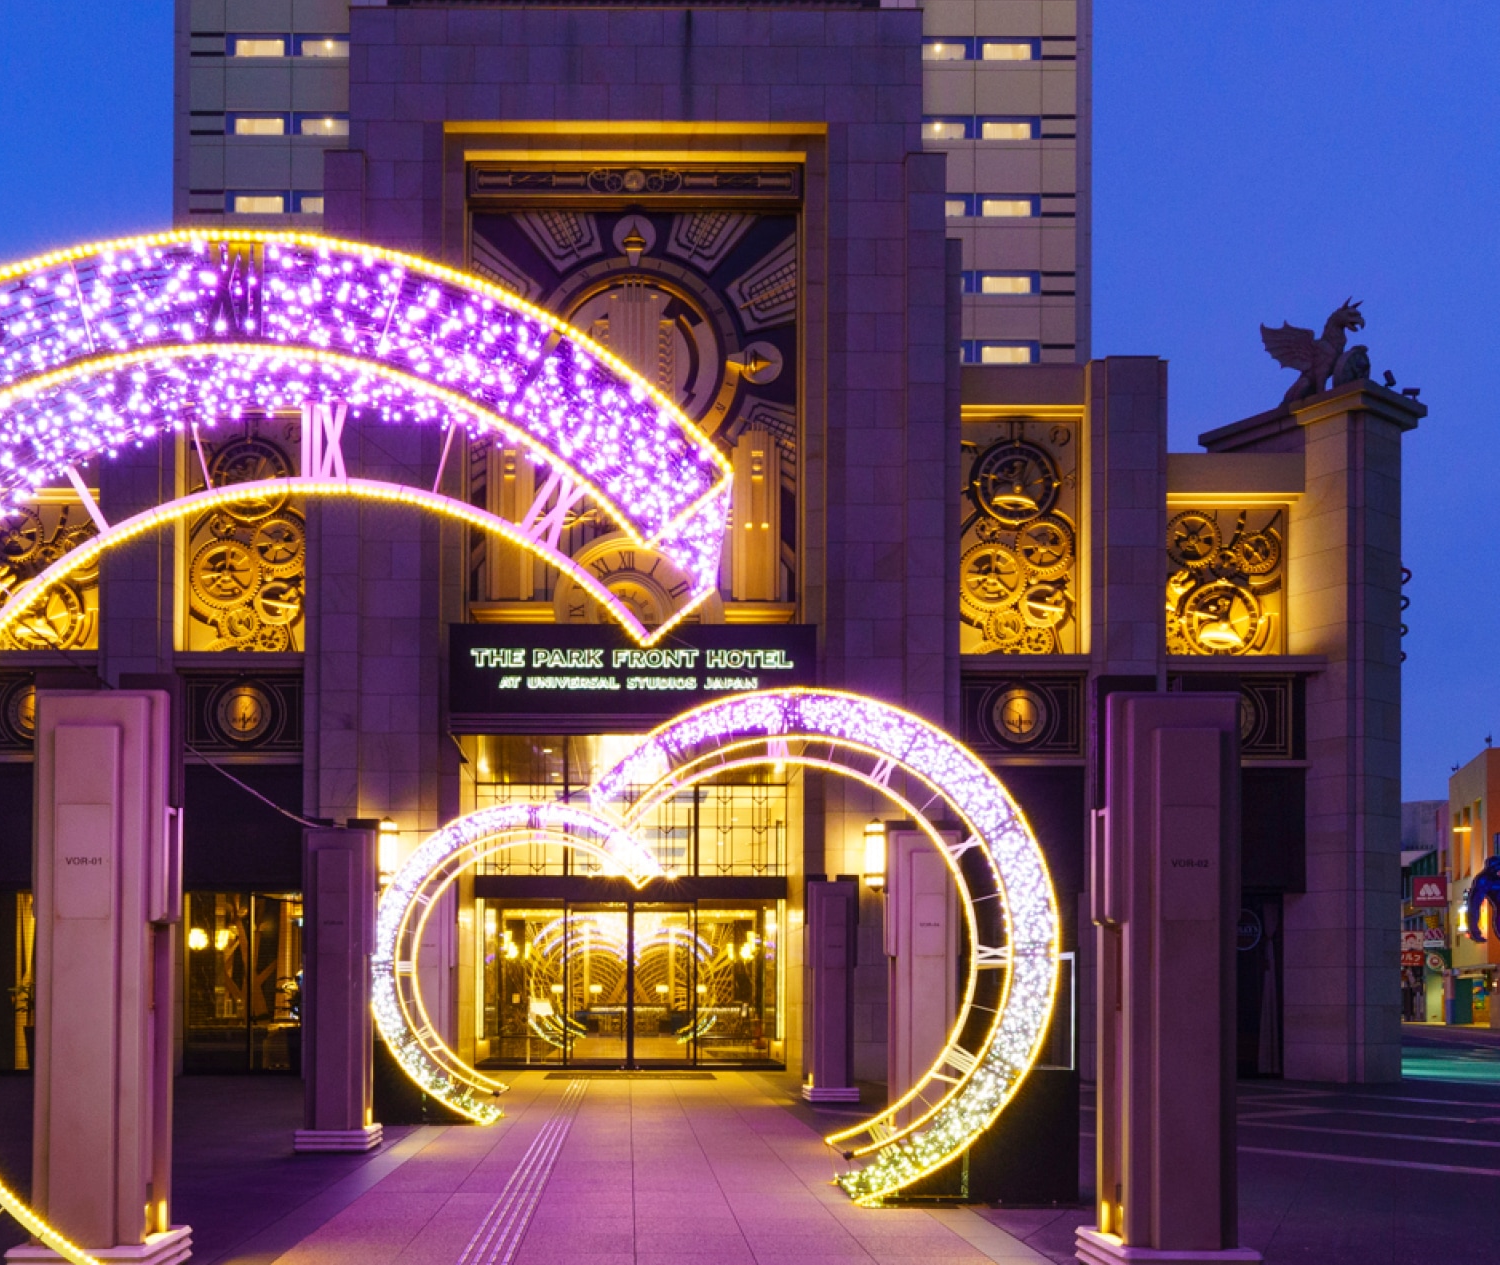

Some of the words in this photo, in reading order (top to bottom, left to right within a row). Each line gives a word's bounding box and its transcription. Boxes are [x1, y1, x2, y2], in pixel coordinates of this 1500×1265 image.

[617, 550, 636, 570] XII
[470, 647, 525, 668] THE
[532, 647, 604, 668] PARK
[612, 647, 700, 668] FRONT
[706, 647, 794, 669] HOTEL
[499, 676, 522, 689] AT
[526, 676, 620, 690] UNIVERSAL
[626, 676, 697, 690] STUDIOS
[704, 676, 758, 691] JAPAN
[65, 856, 103, 866] VOR-01
[1171, 858, 1210, 868] VOR-02
